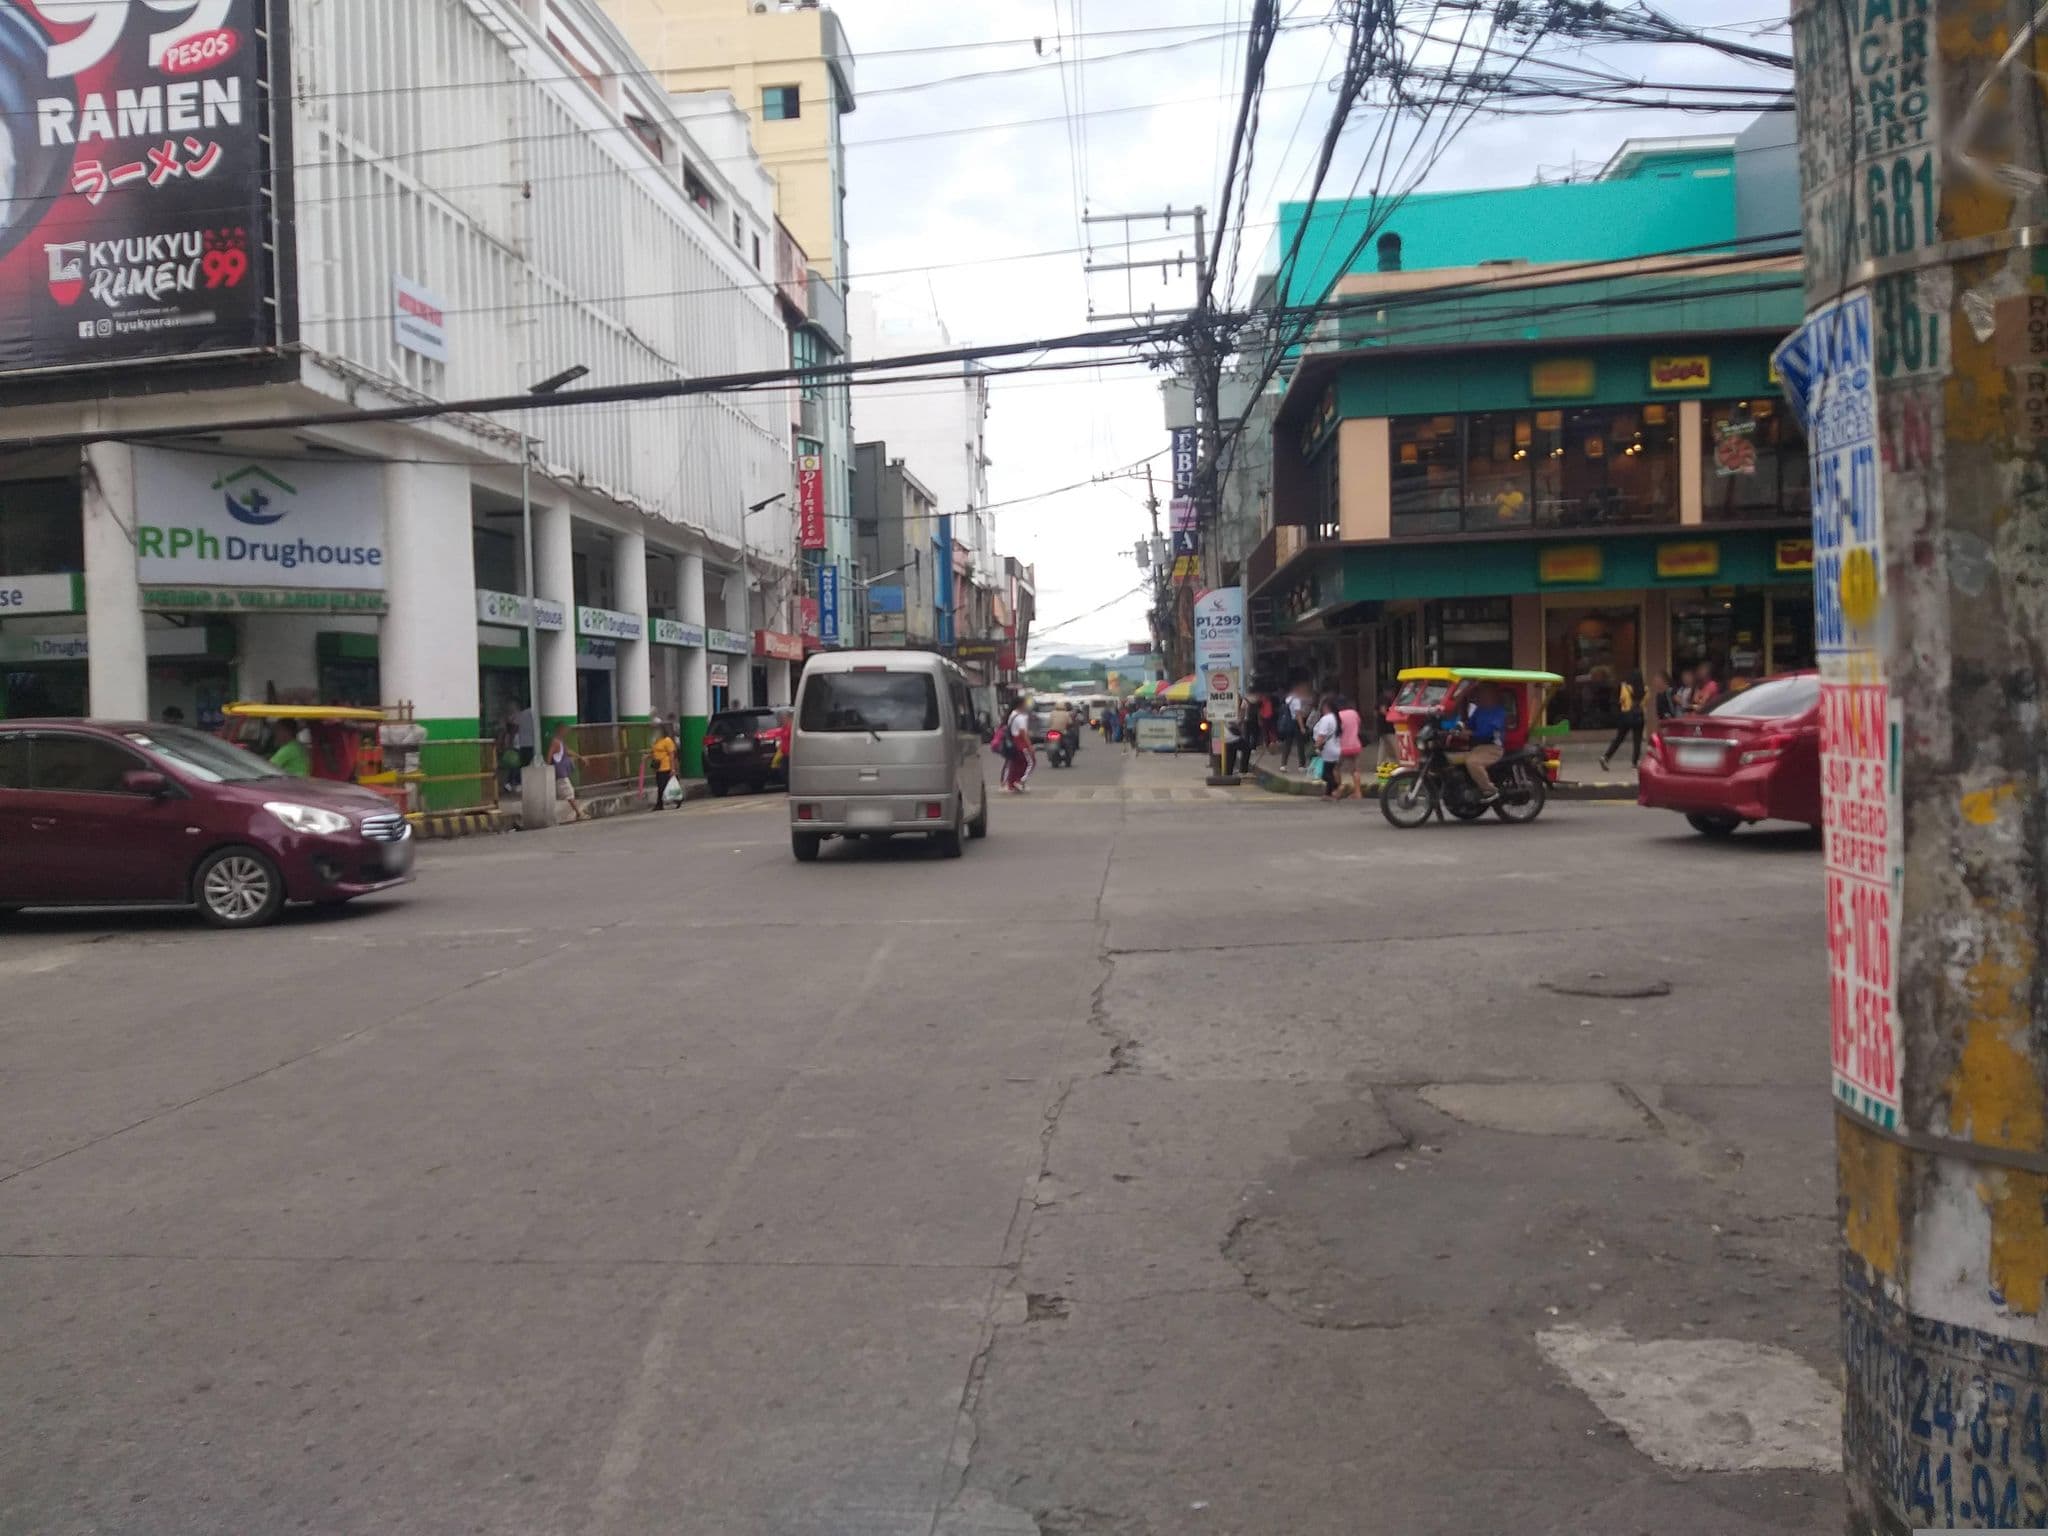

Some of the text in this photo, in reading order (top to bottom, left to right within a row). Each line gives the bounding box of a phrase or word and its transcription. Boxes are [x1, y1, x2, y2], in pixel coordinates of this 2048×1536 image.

[166, 33, 231, 73] PESOS
[36, 76, 241, 147] RAMEN
[72, 136, 223, 205] ラーメン
[89, 230, 203, 267] KYUKYU
[203, 249, 248, 288] 99
[89, 257, 202, 308] RAMEN
[137, 525, 382, 569] RPh Drughouse
[1195, 615, 1242, 628] P1,299
